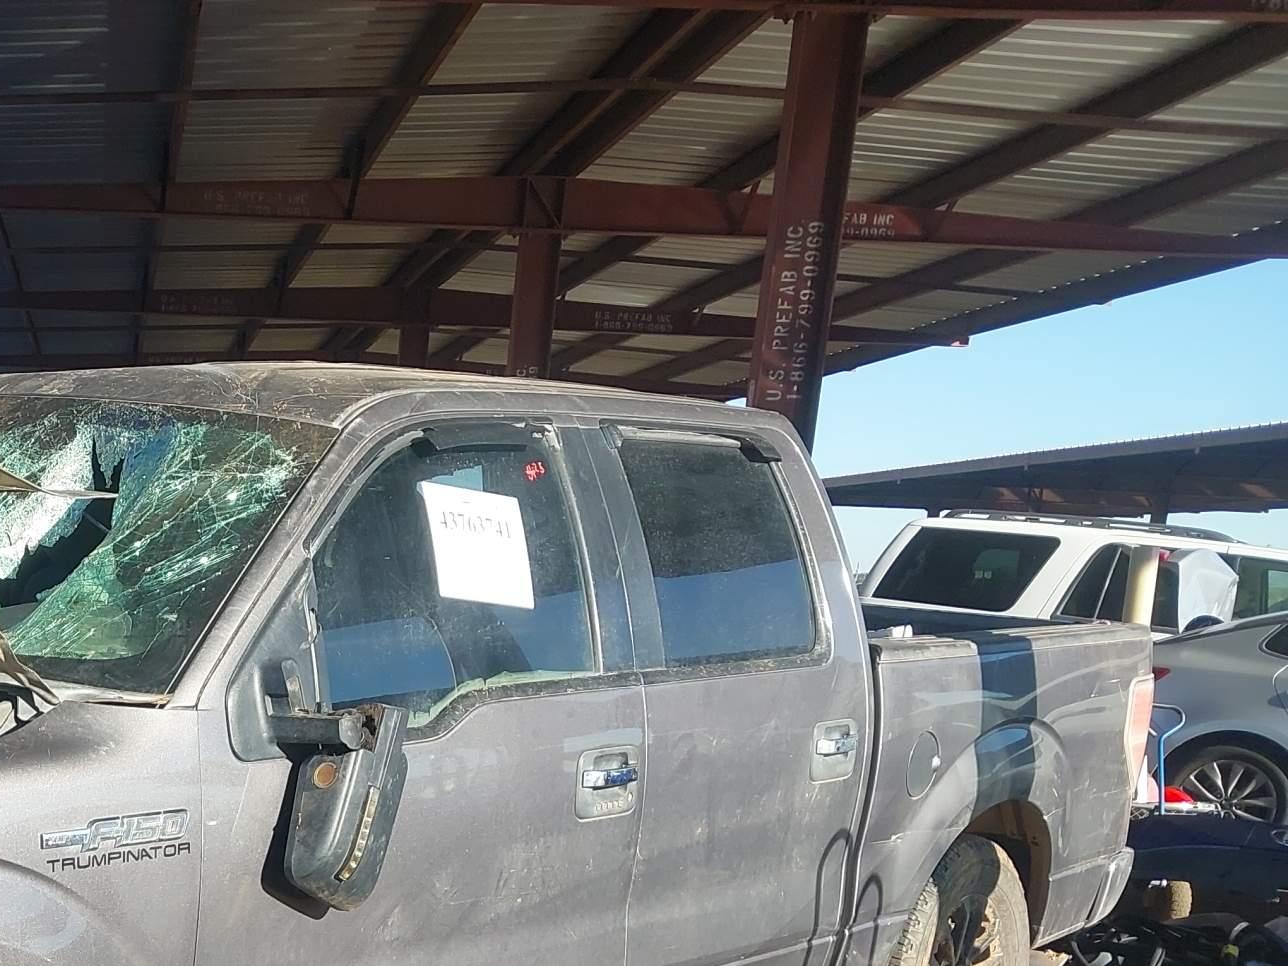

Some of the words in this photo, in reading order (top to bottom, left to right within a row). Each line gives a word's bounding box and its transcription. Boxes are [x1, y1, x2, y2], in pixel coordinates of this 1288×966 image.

[873, 213, 895, 226] INC
[784, 226, 804, 259] INC
[772, 270, 799, 351] PREFAB
[786, 221, 825, 400] 1-866-799-0969
[766, 363, 786, 401] U.S.
[46, 842, 191, 873] TRUMPINATOR
